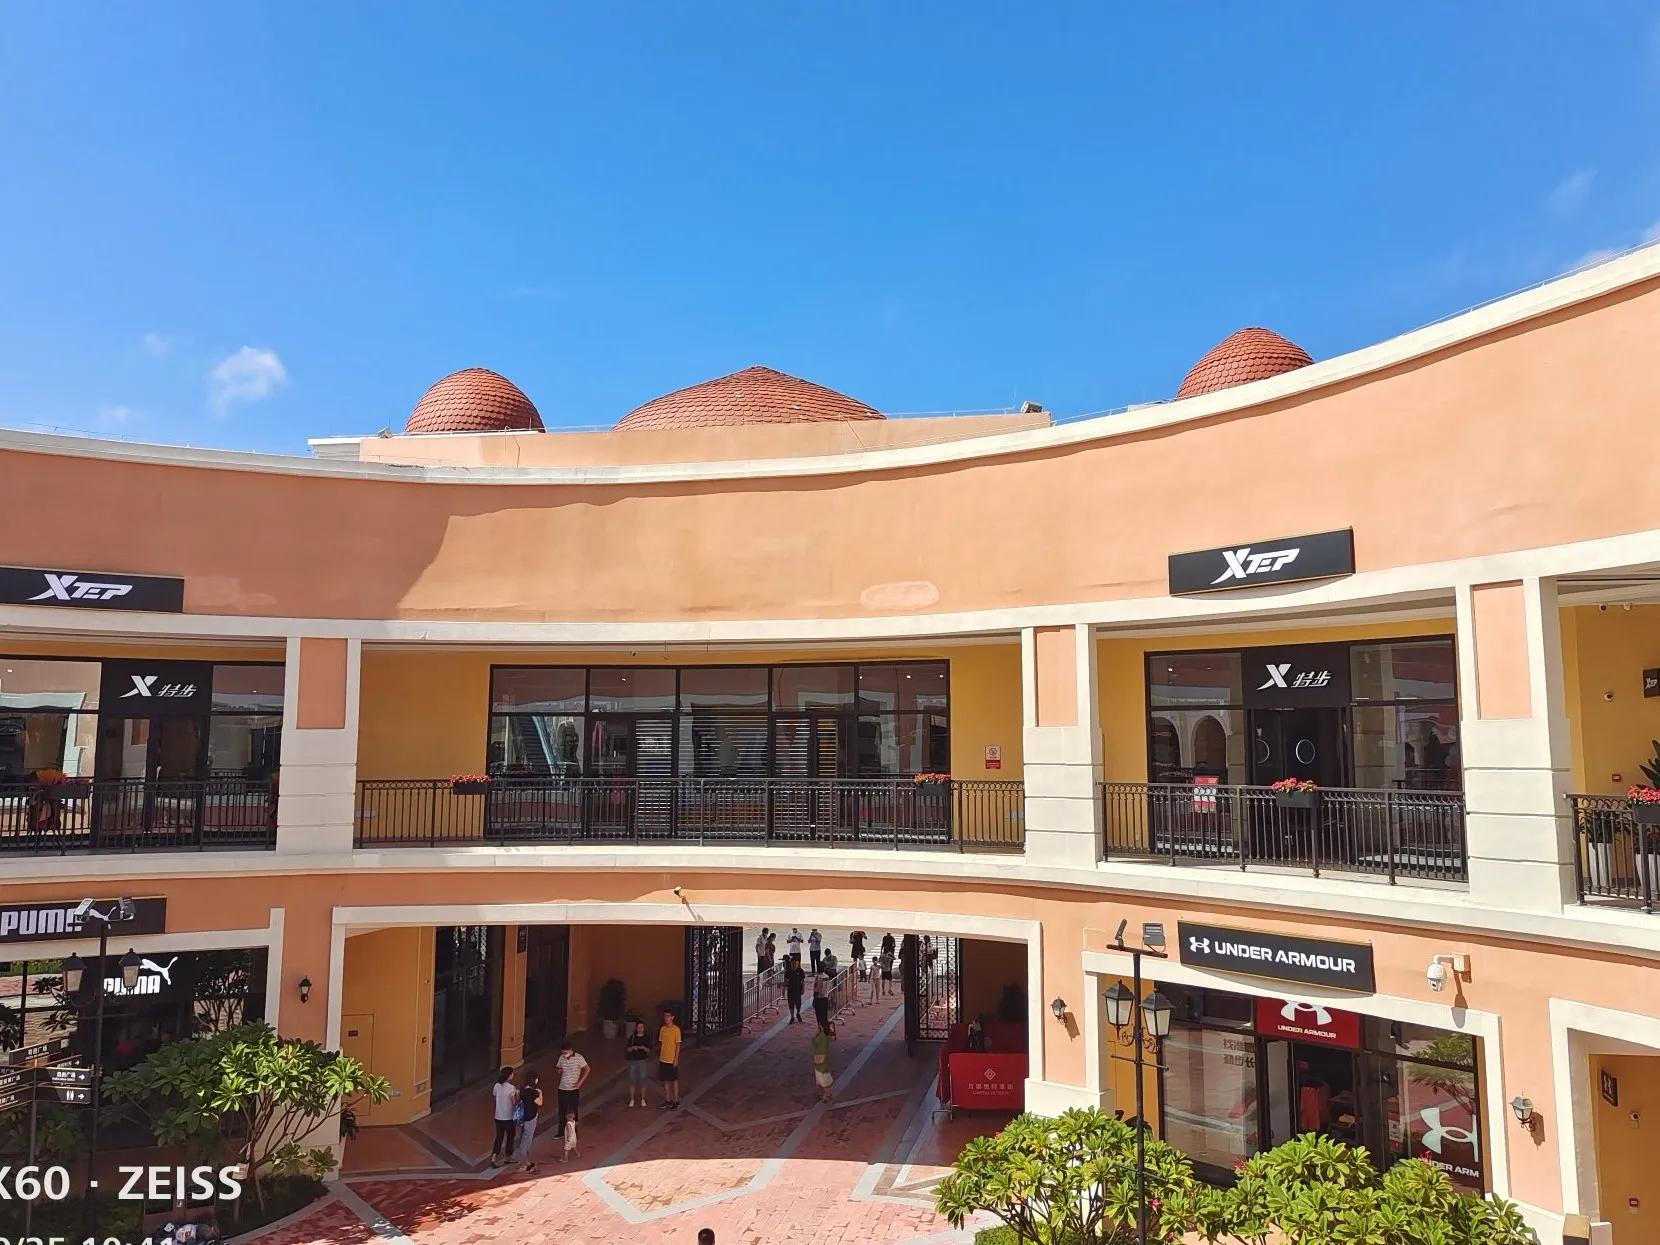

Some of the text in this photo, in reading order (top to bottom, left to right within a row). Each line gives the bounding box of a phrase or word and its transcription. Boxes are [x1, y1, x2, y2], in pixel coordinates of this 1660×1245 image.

[1210, 548, 1300, 584] XTEP
[26, 573, 133, 600] XTEP
[1214, 941, 1356, 973] UNDER ARMOUR
[1277, 1024, 1337, 1039] UNDER ARMOUR
